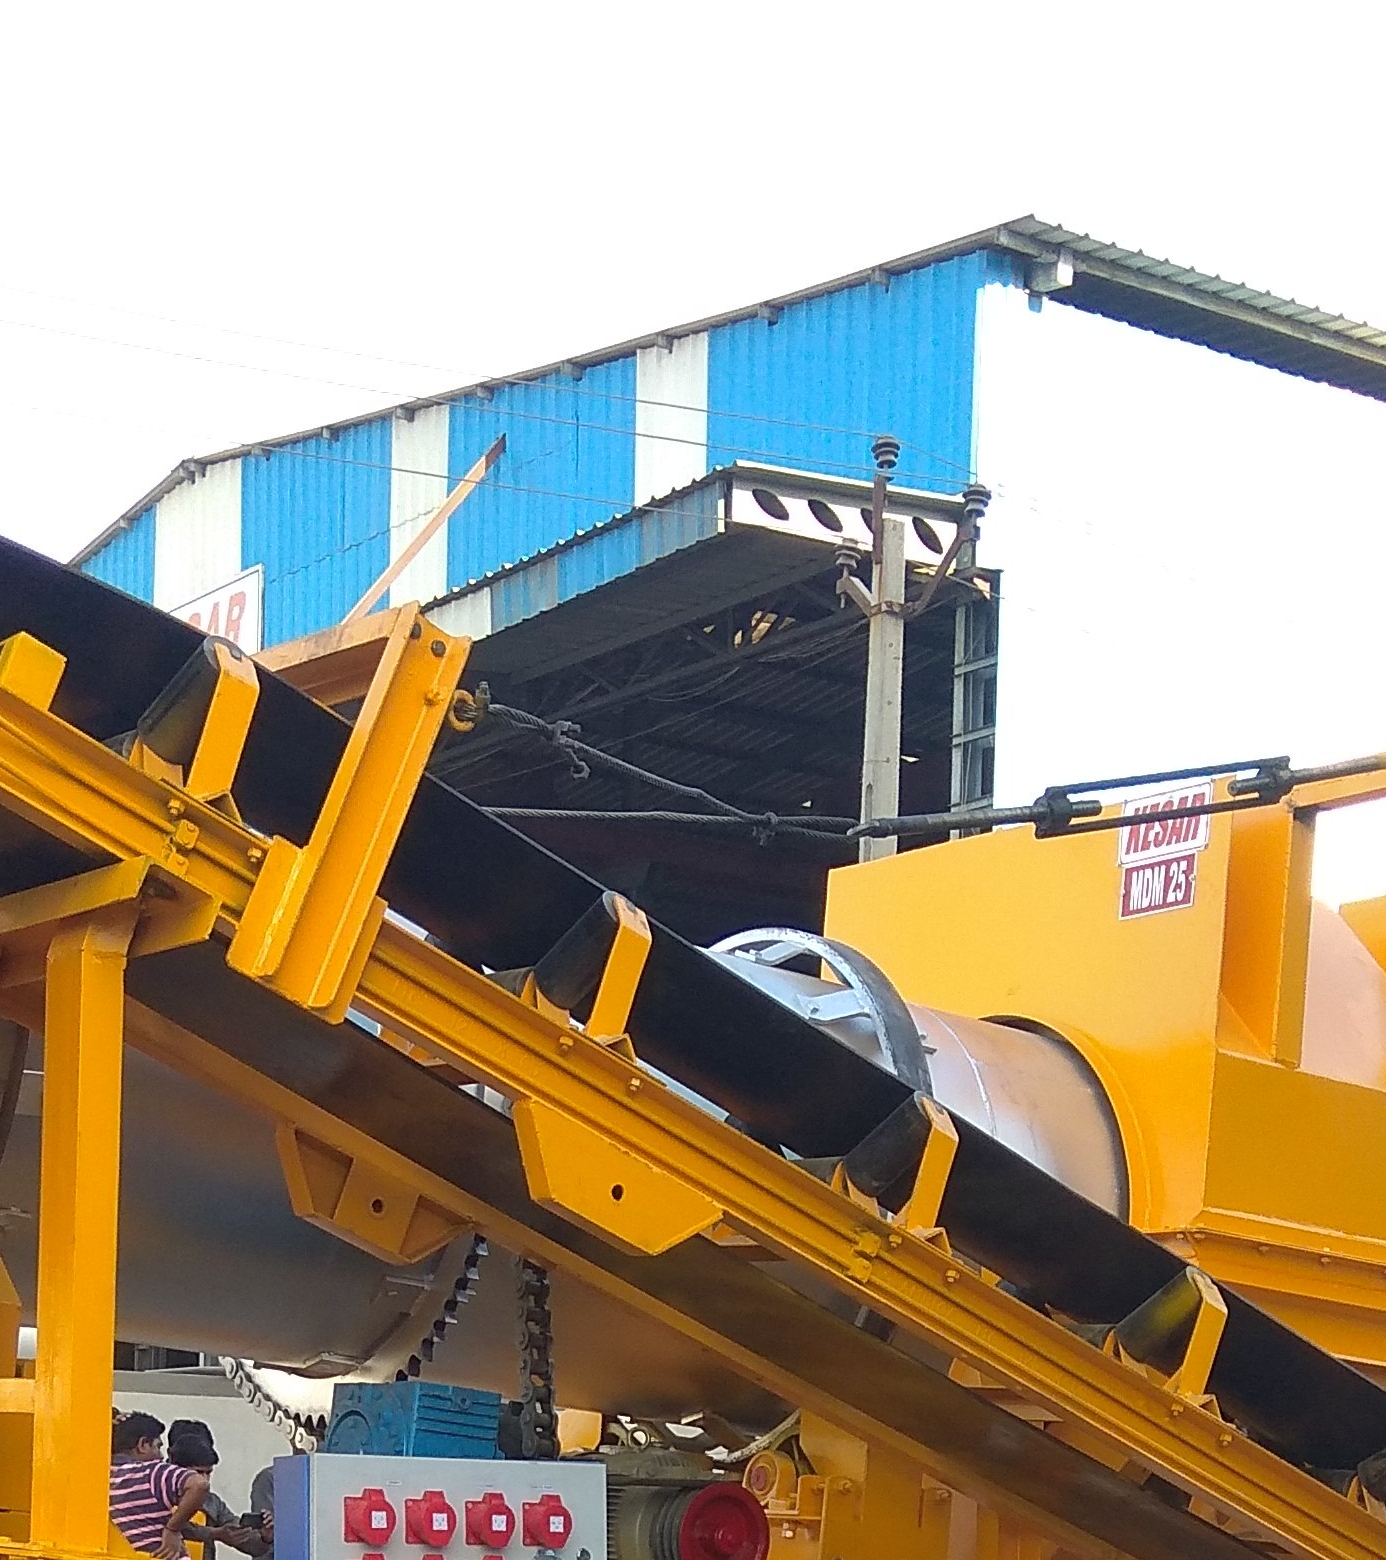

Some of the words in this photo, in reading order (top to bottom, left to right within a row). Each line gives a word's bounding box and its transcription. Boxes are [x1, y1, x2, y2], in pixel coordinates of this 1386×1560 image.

[1125, 793, 1206, 855] KESAR
[1129, 866, 1166, 911] MDM
[1166, 861, 1188, 903] 25
